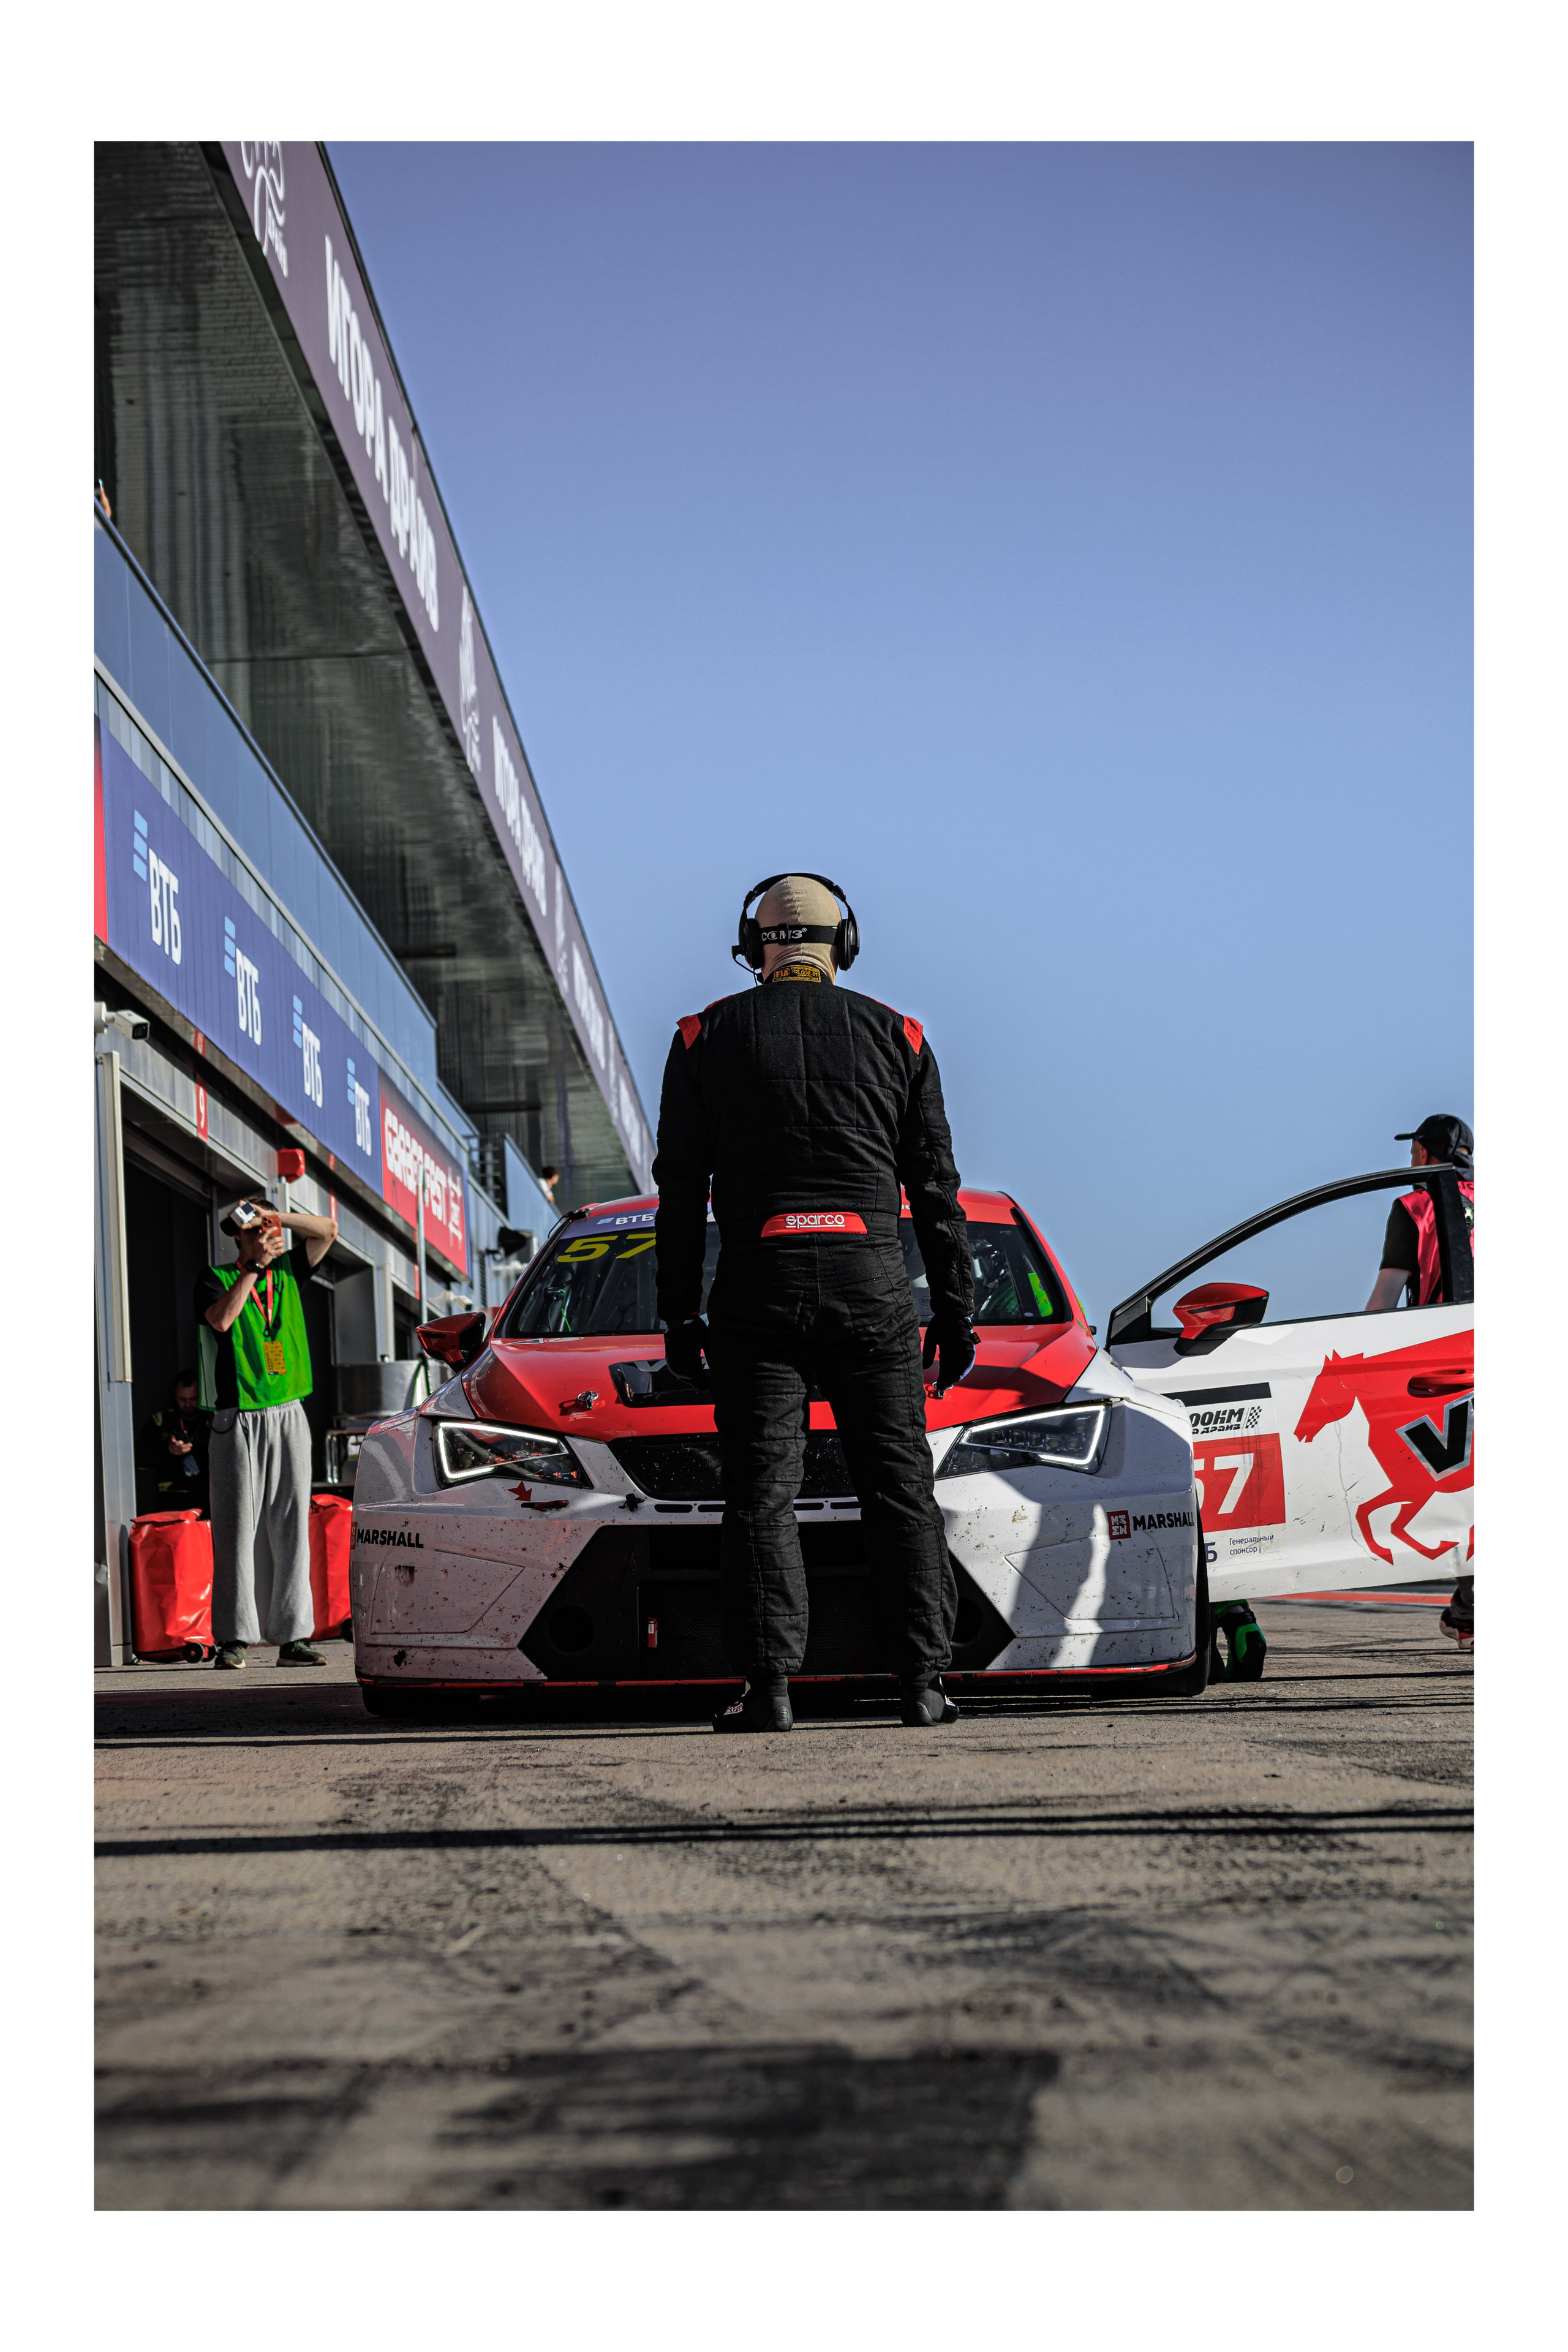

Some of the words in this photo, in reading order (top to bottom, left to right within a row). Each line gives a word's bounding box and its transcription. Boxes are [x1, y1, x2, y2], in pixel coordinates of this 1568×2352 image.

[325, 235, 389, 505] ИГОРА
[388, 417, 439, 632] ДРАЙВ
[149, 848, 183, 966] ВТБ
[775, 969, 789, 978] FIA
[236, 946, 262, 1047] ВТБ
[302, 1022, 323, 1109] ВТБ
[355, 1080, 372, 1157] ВТБ
[615, 1213, 655, 1226] ВТБ
[785, 1214, 845, 1229] sparco
[557, 1233, 657, 1263] 57
[1132, 1511, 1194, 1531] MARSHALL
[356, 1528, 424, 1549] MARSHALL
[1229, 1533, 1274, 1545] Генеральный
[1229, 1547, 1257, 1555] спонсор
